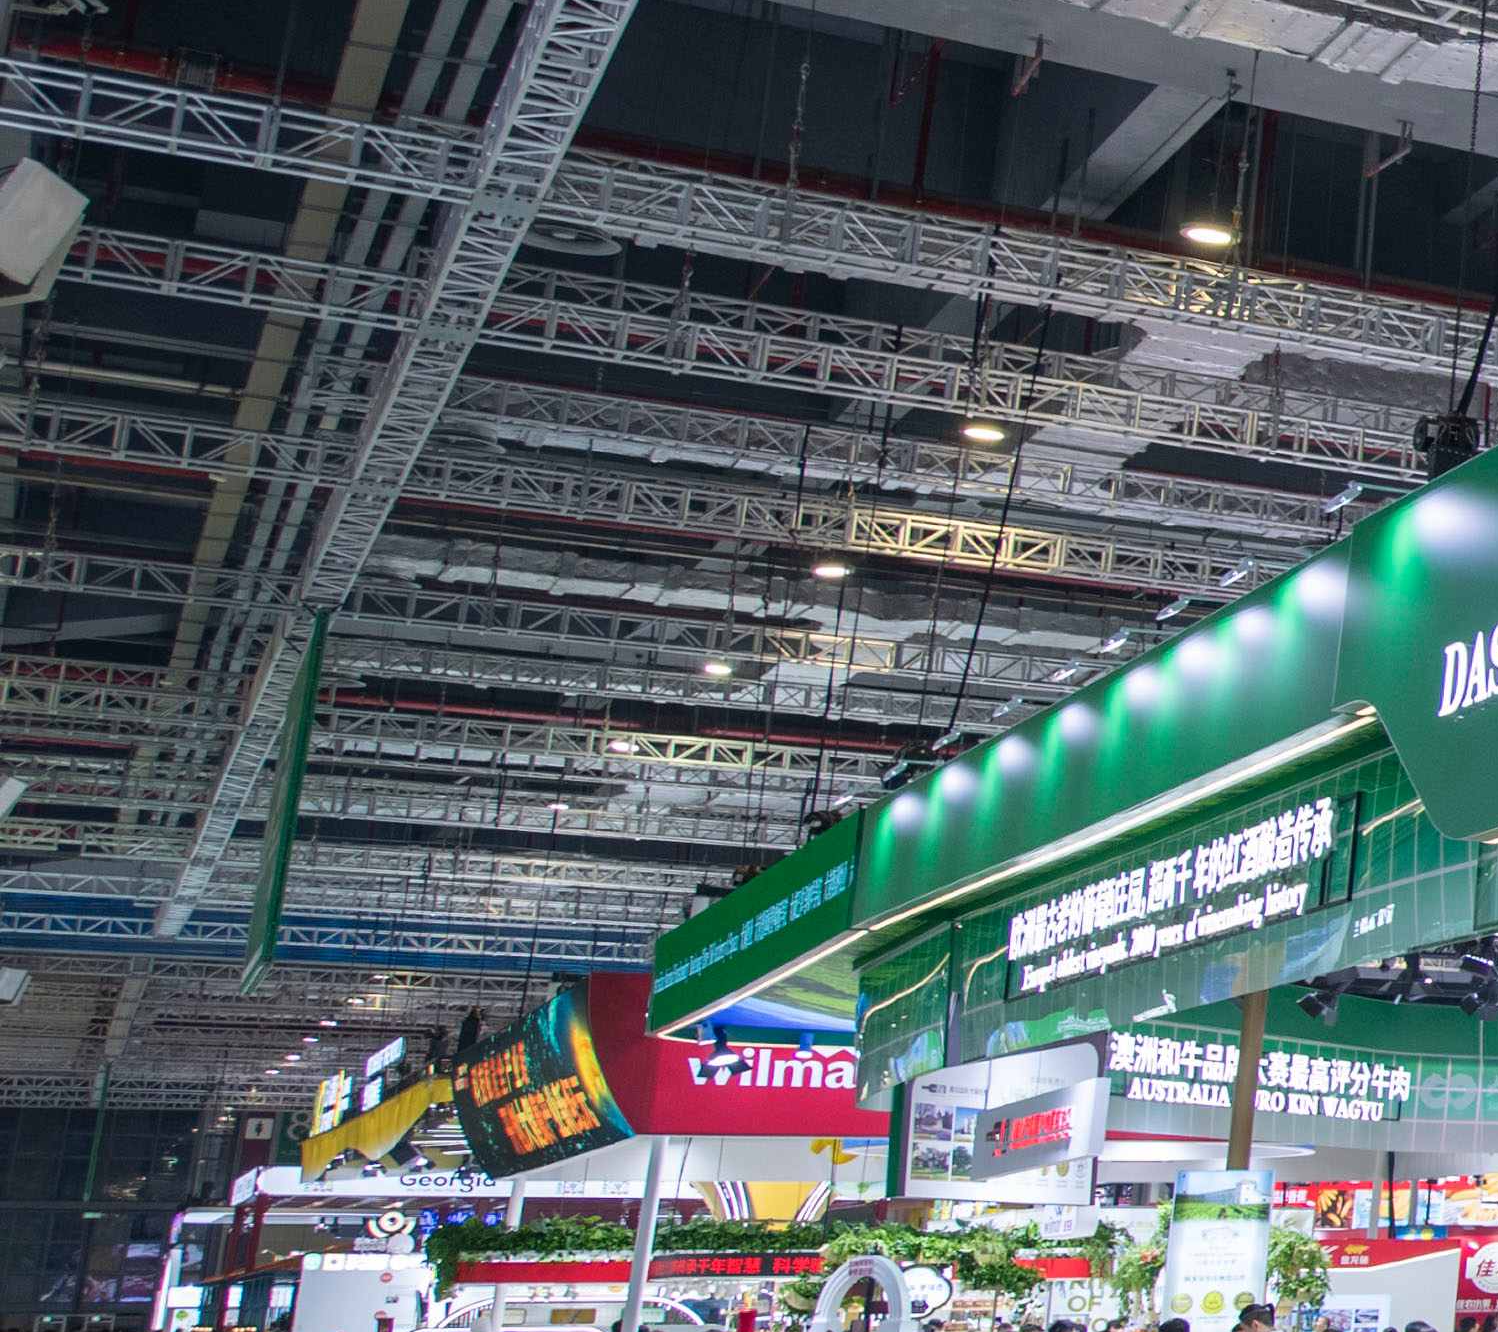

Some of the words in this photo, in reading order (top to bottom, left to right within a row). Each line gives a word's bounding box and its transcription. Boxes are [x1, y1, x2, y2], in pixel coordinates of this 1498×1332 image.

[1127, 1076, 1232, 1109] AUSTRALIA
[1287, 1093, 1320, 1117] KIN
[1323, 1096, 1386, 1123] WAGYU
